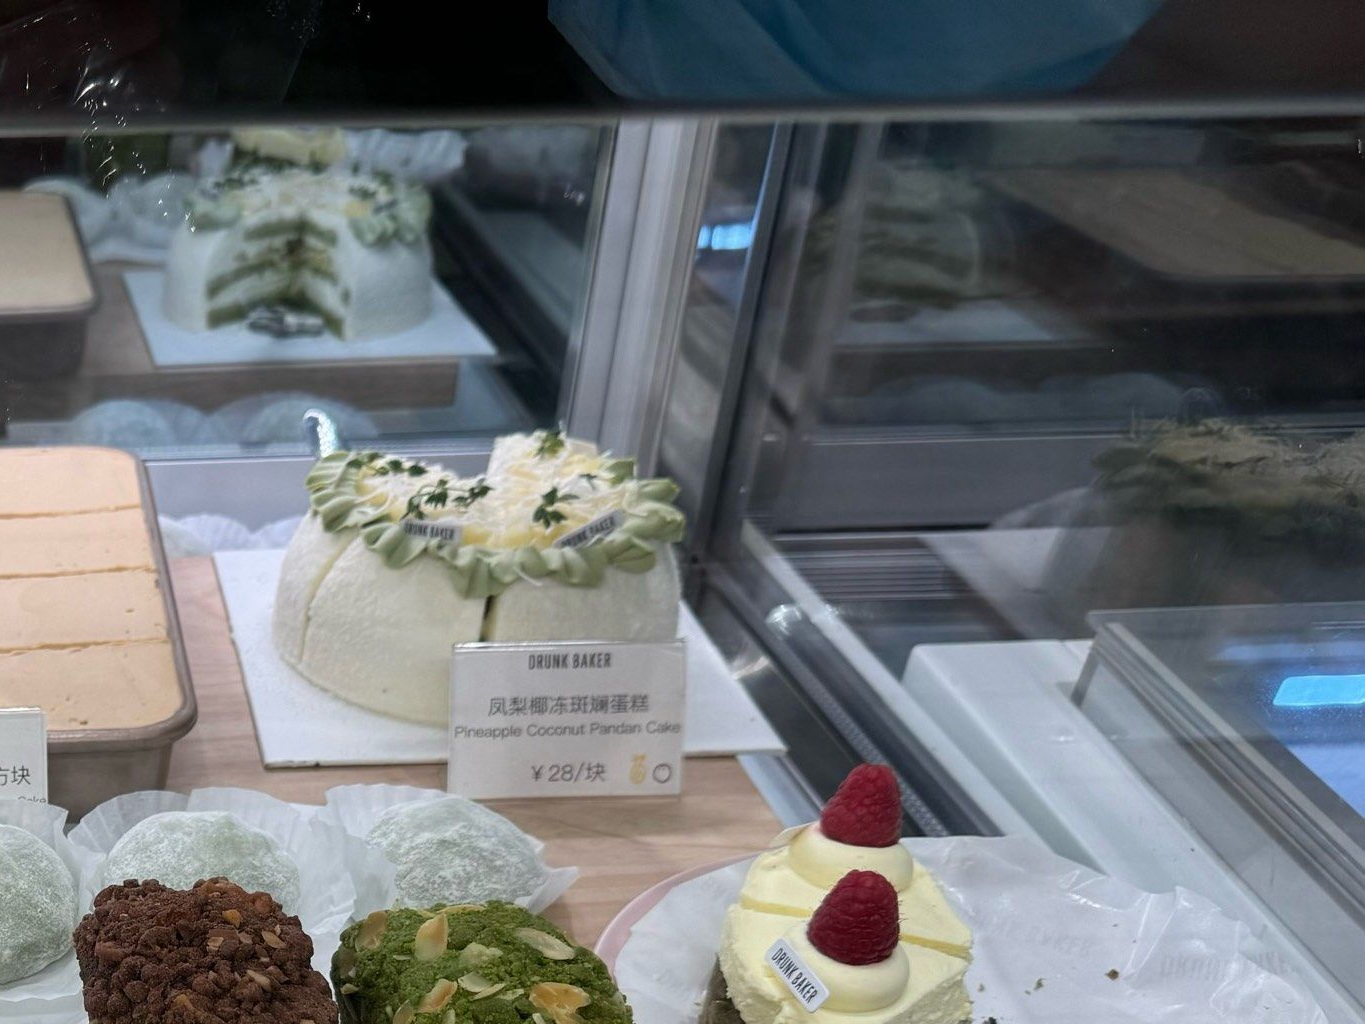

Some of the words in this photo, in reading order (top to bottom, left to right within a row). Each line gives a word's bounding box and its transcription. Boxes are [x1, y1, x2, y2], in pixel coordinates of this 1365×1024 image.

[528, 653, 568, 670] DRUNK
[572, 652, 611, 669] BAKER
[454, 726, 522, 740] Pineapple
[526, 724, 585, 737] Coconut
[590, 722, 641, 735] Pandan
[646, 720, 682, 734] Cake
[771, 948, 798, 979] DRUNK
[791, 972, 818, 1004] BAKER
